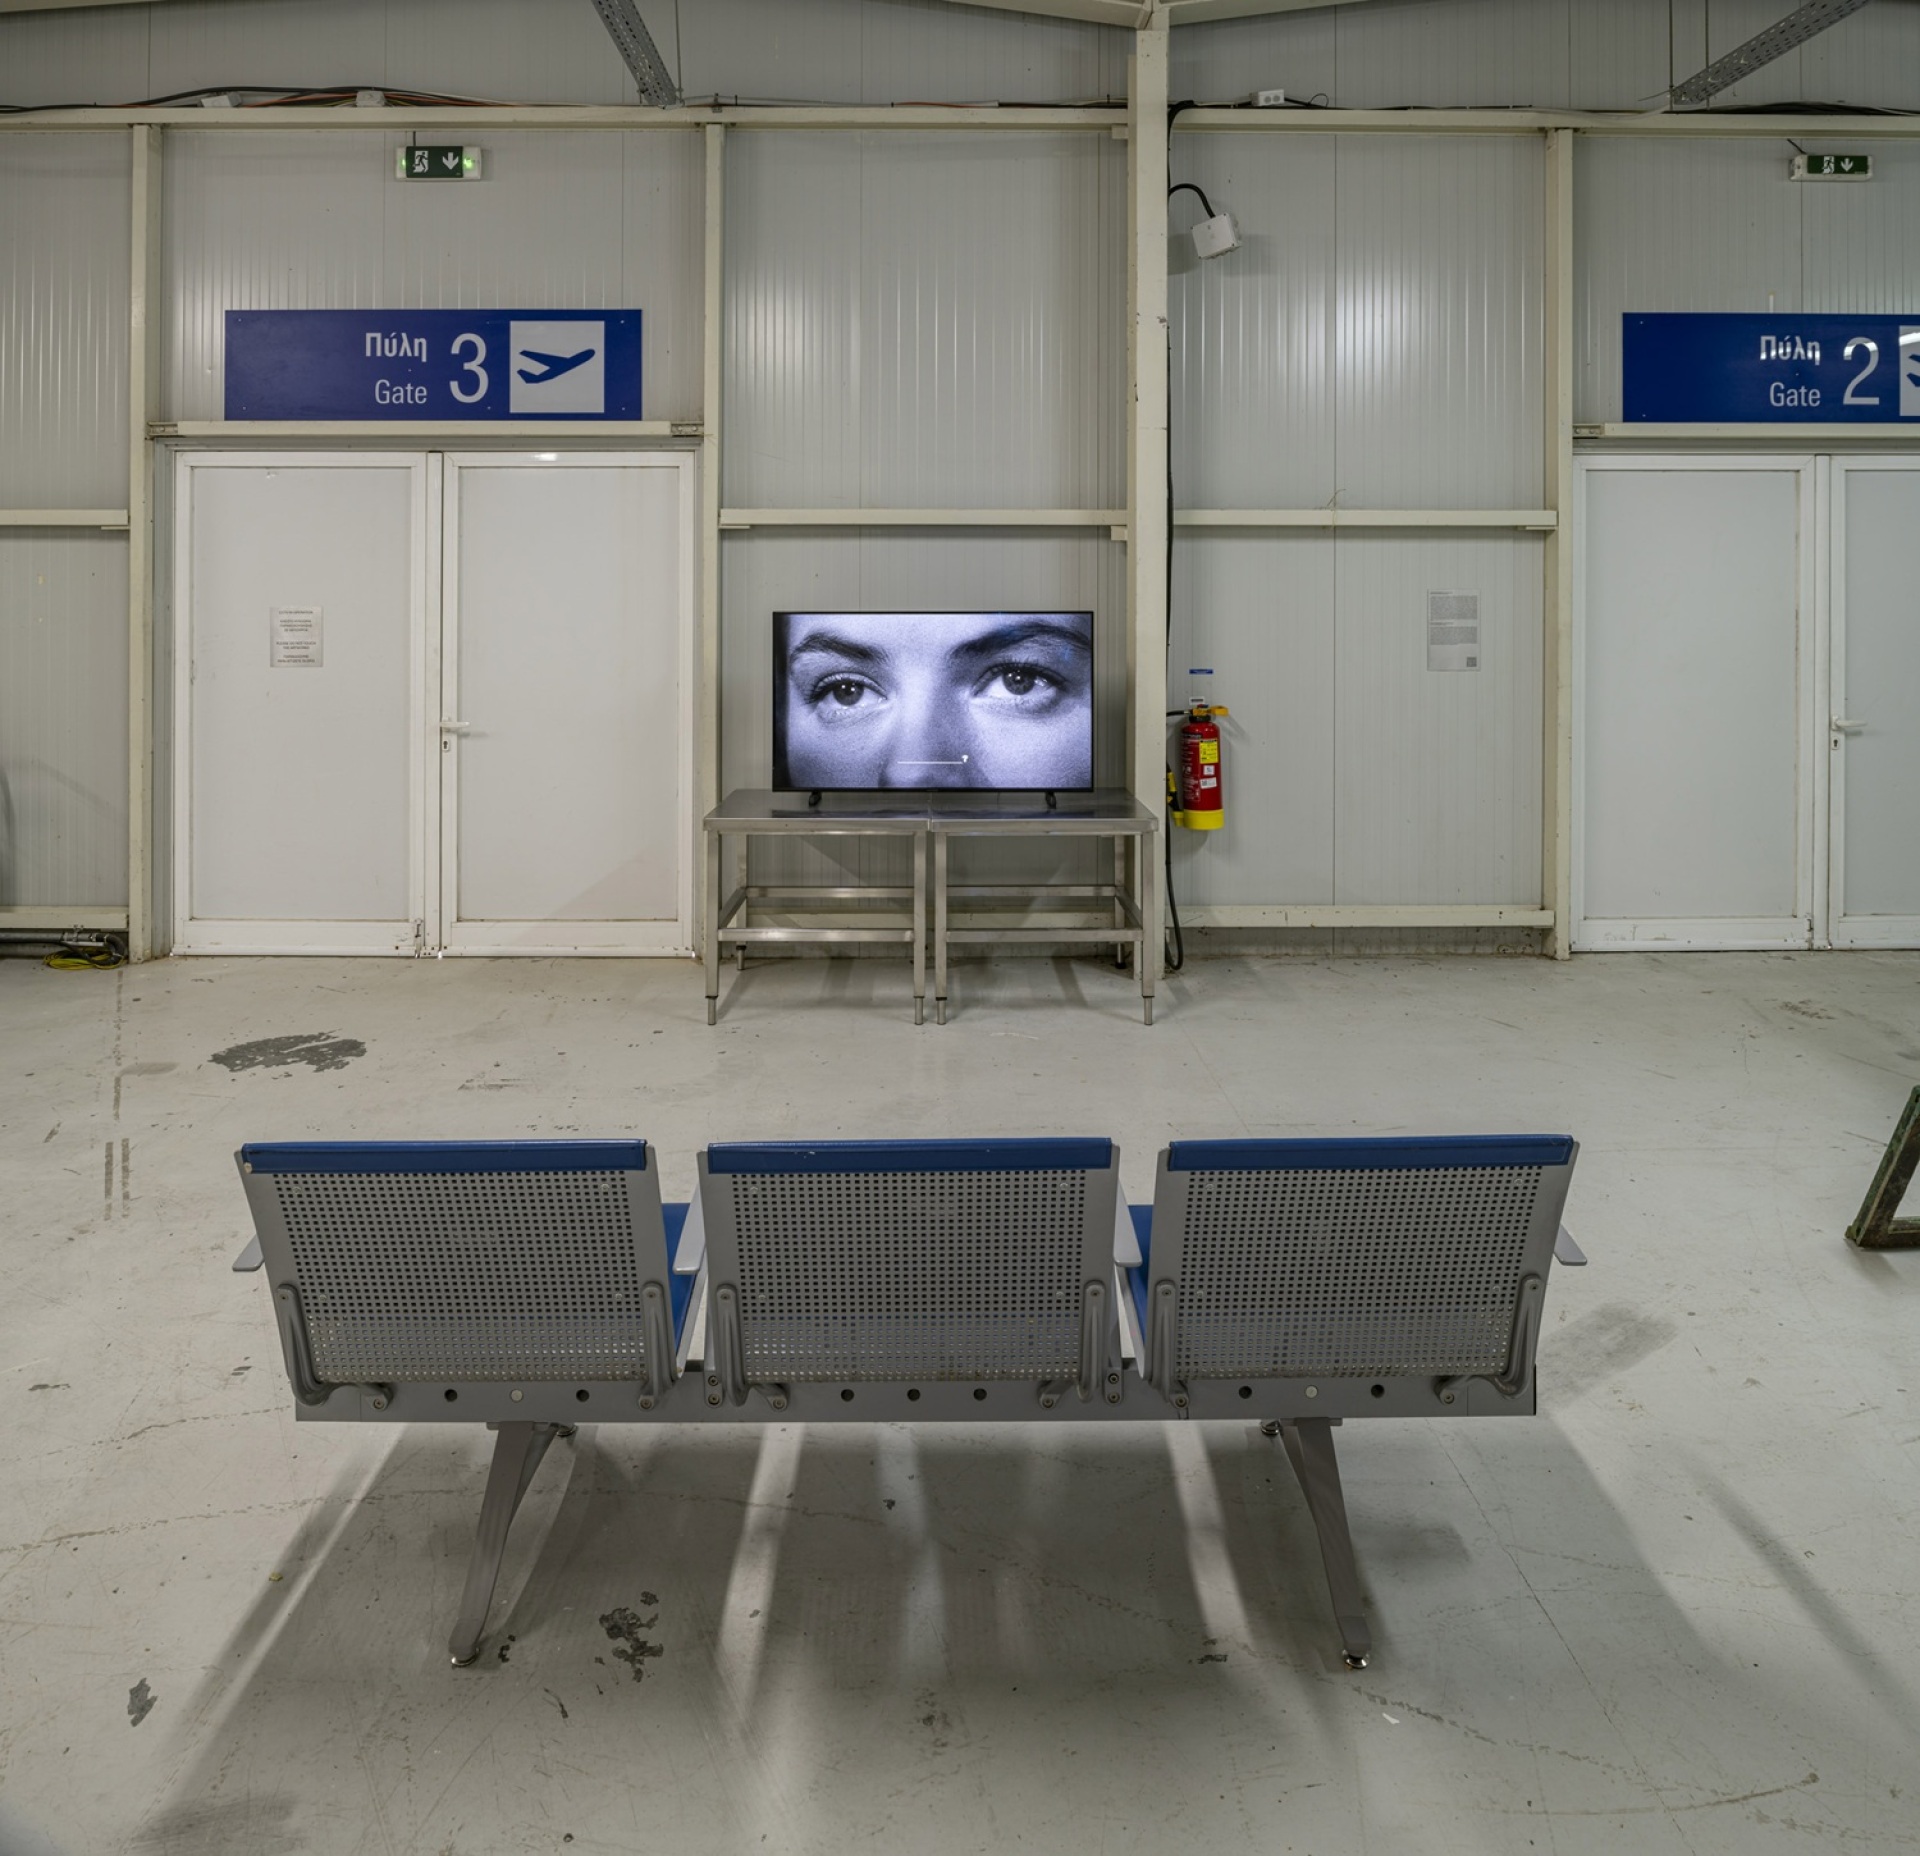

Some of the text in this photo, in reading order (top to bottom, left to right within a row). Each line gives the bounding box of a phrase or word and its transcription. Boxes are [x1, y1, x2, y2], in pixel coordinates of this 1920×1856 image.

[365, 332, 427, 363] Πύλη
[1759, 336, 1821, 366] Πύλη
[449, 333, 489, 403] 3
[1843, 337, 1880, 405] 2
[374, 379, 427, 404] Gate
[1769, 381, 1821, 407] Gate
